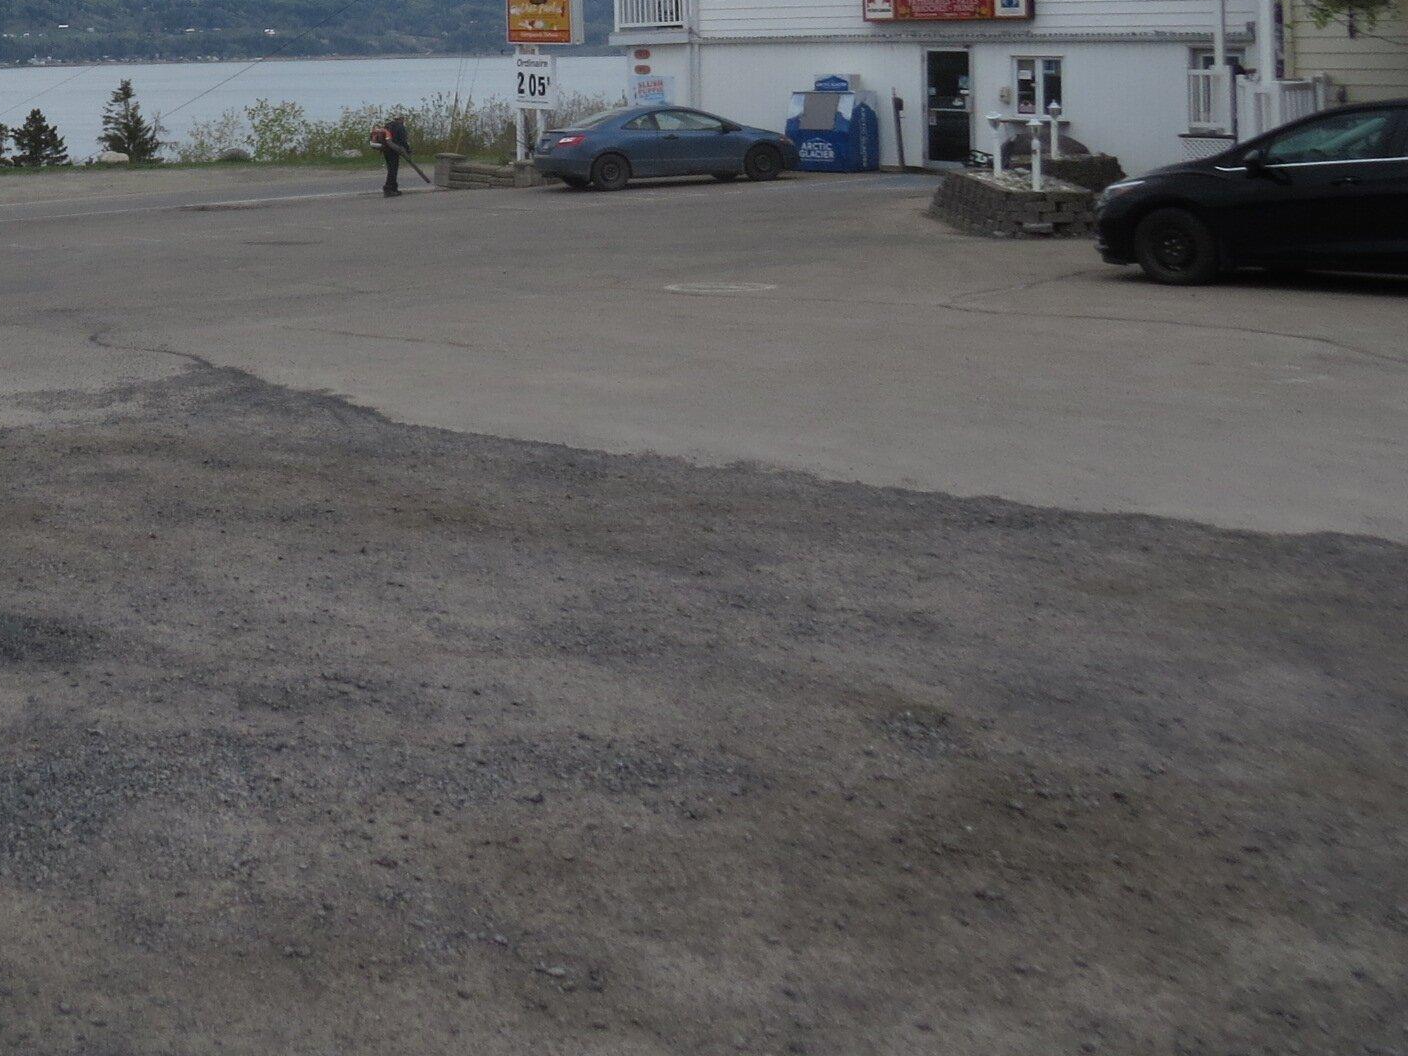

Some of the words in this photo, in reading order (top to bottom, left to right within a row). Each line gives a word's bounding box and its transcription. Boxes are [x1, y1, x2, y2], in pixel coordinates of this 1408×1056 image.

[516, 58, 549, 68] Ordinaire
[800, 142, 833, 150] ARCTIC
[798, 149, 835, 158] GLACIER
